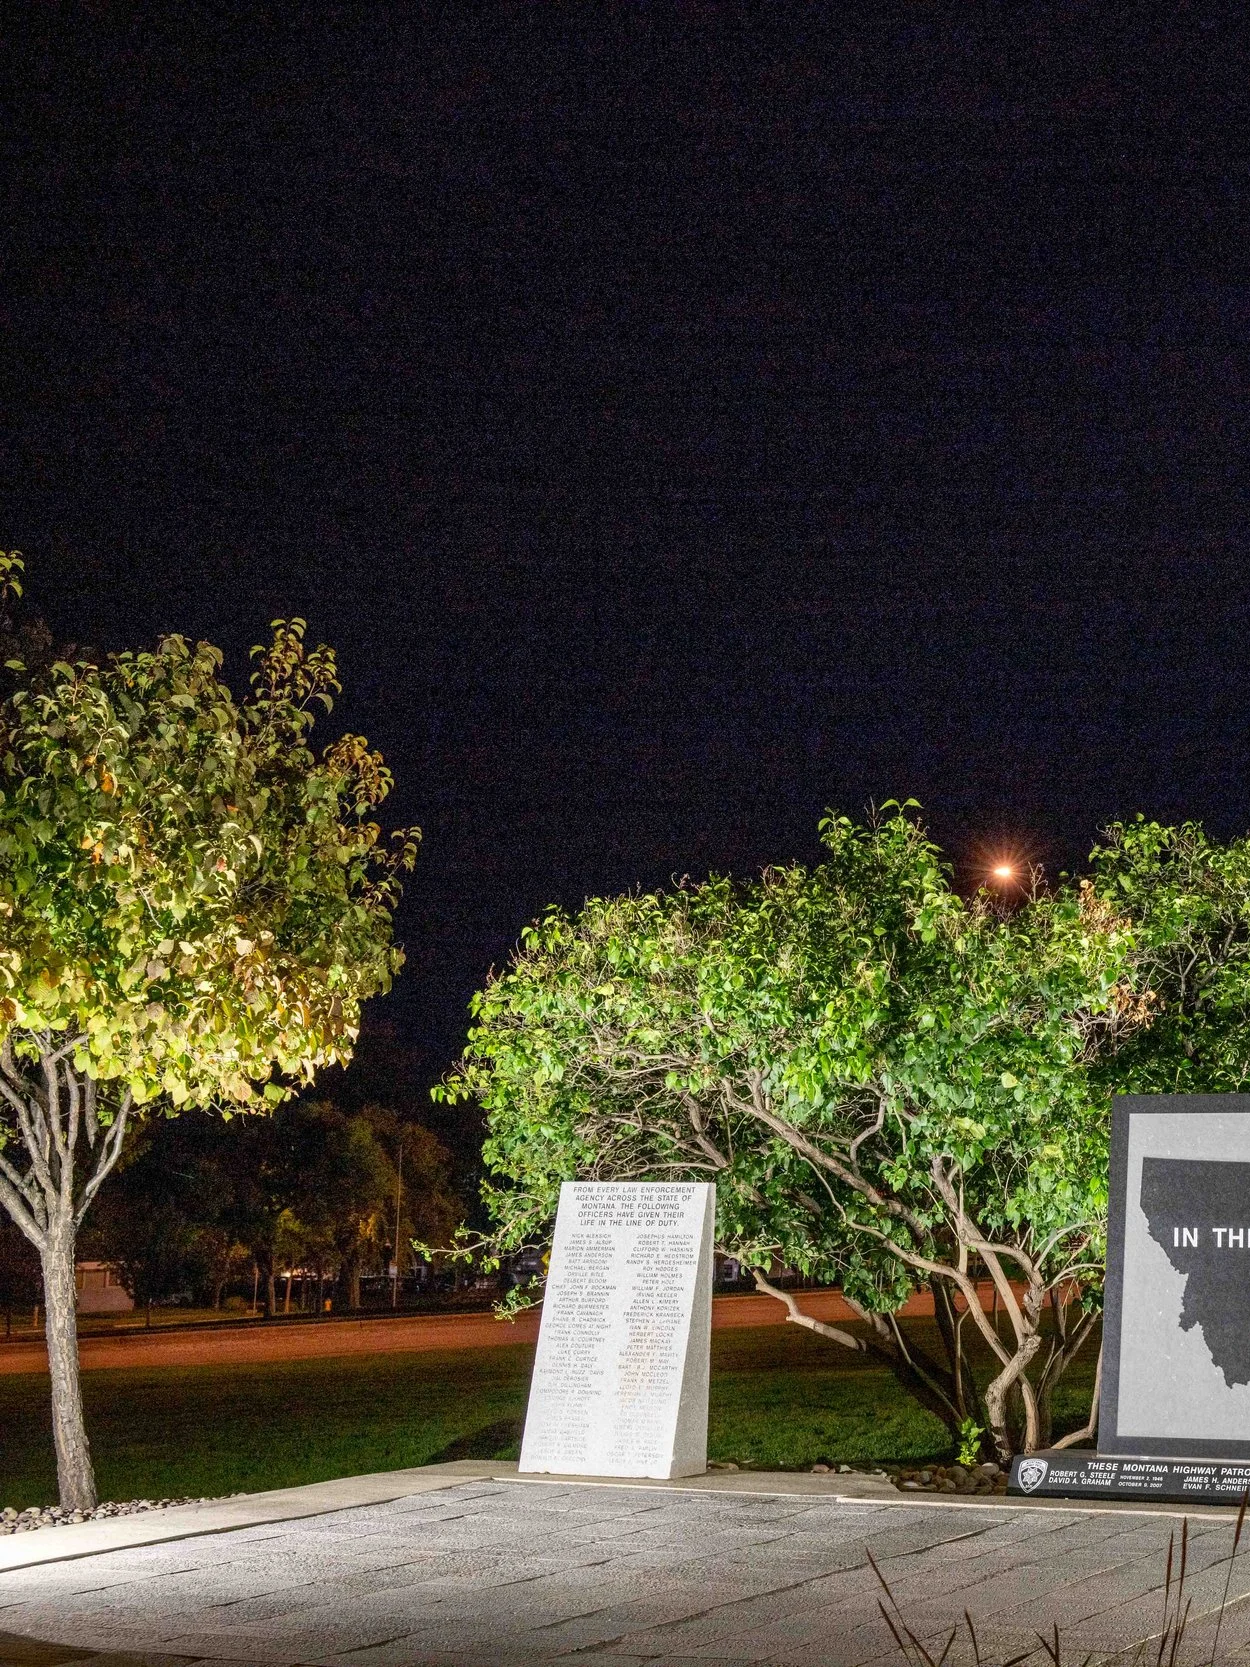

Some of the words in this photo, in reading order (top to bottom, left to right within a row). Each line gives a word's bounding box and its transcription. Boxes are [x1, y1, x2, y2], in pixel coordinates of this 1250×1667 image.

[1173, 1227, 1198, 1247] IN
[1087, 1462, 1118, 1471] THESE
[1123, 1464, 1168, 1473] MONTANA
[1172, 1466, 1217, 1475] HIGHWAY
[1081, 1478, 1111, 1486] GRAHAM
